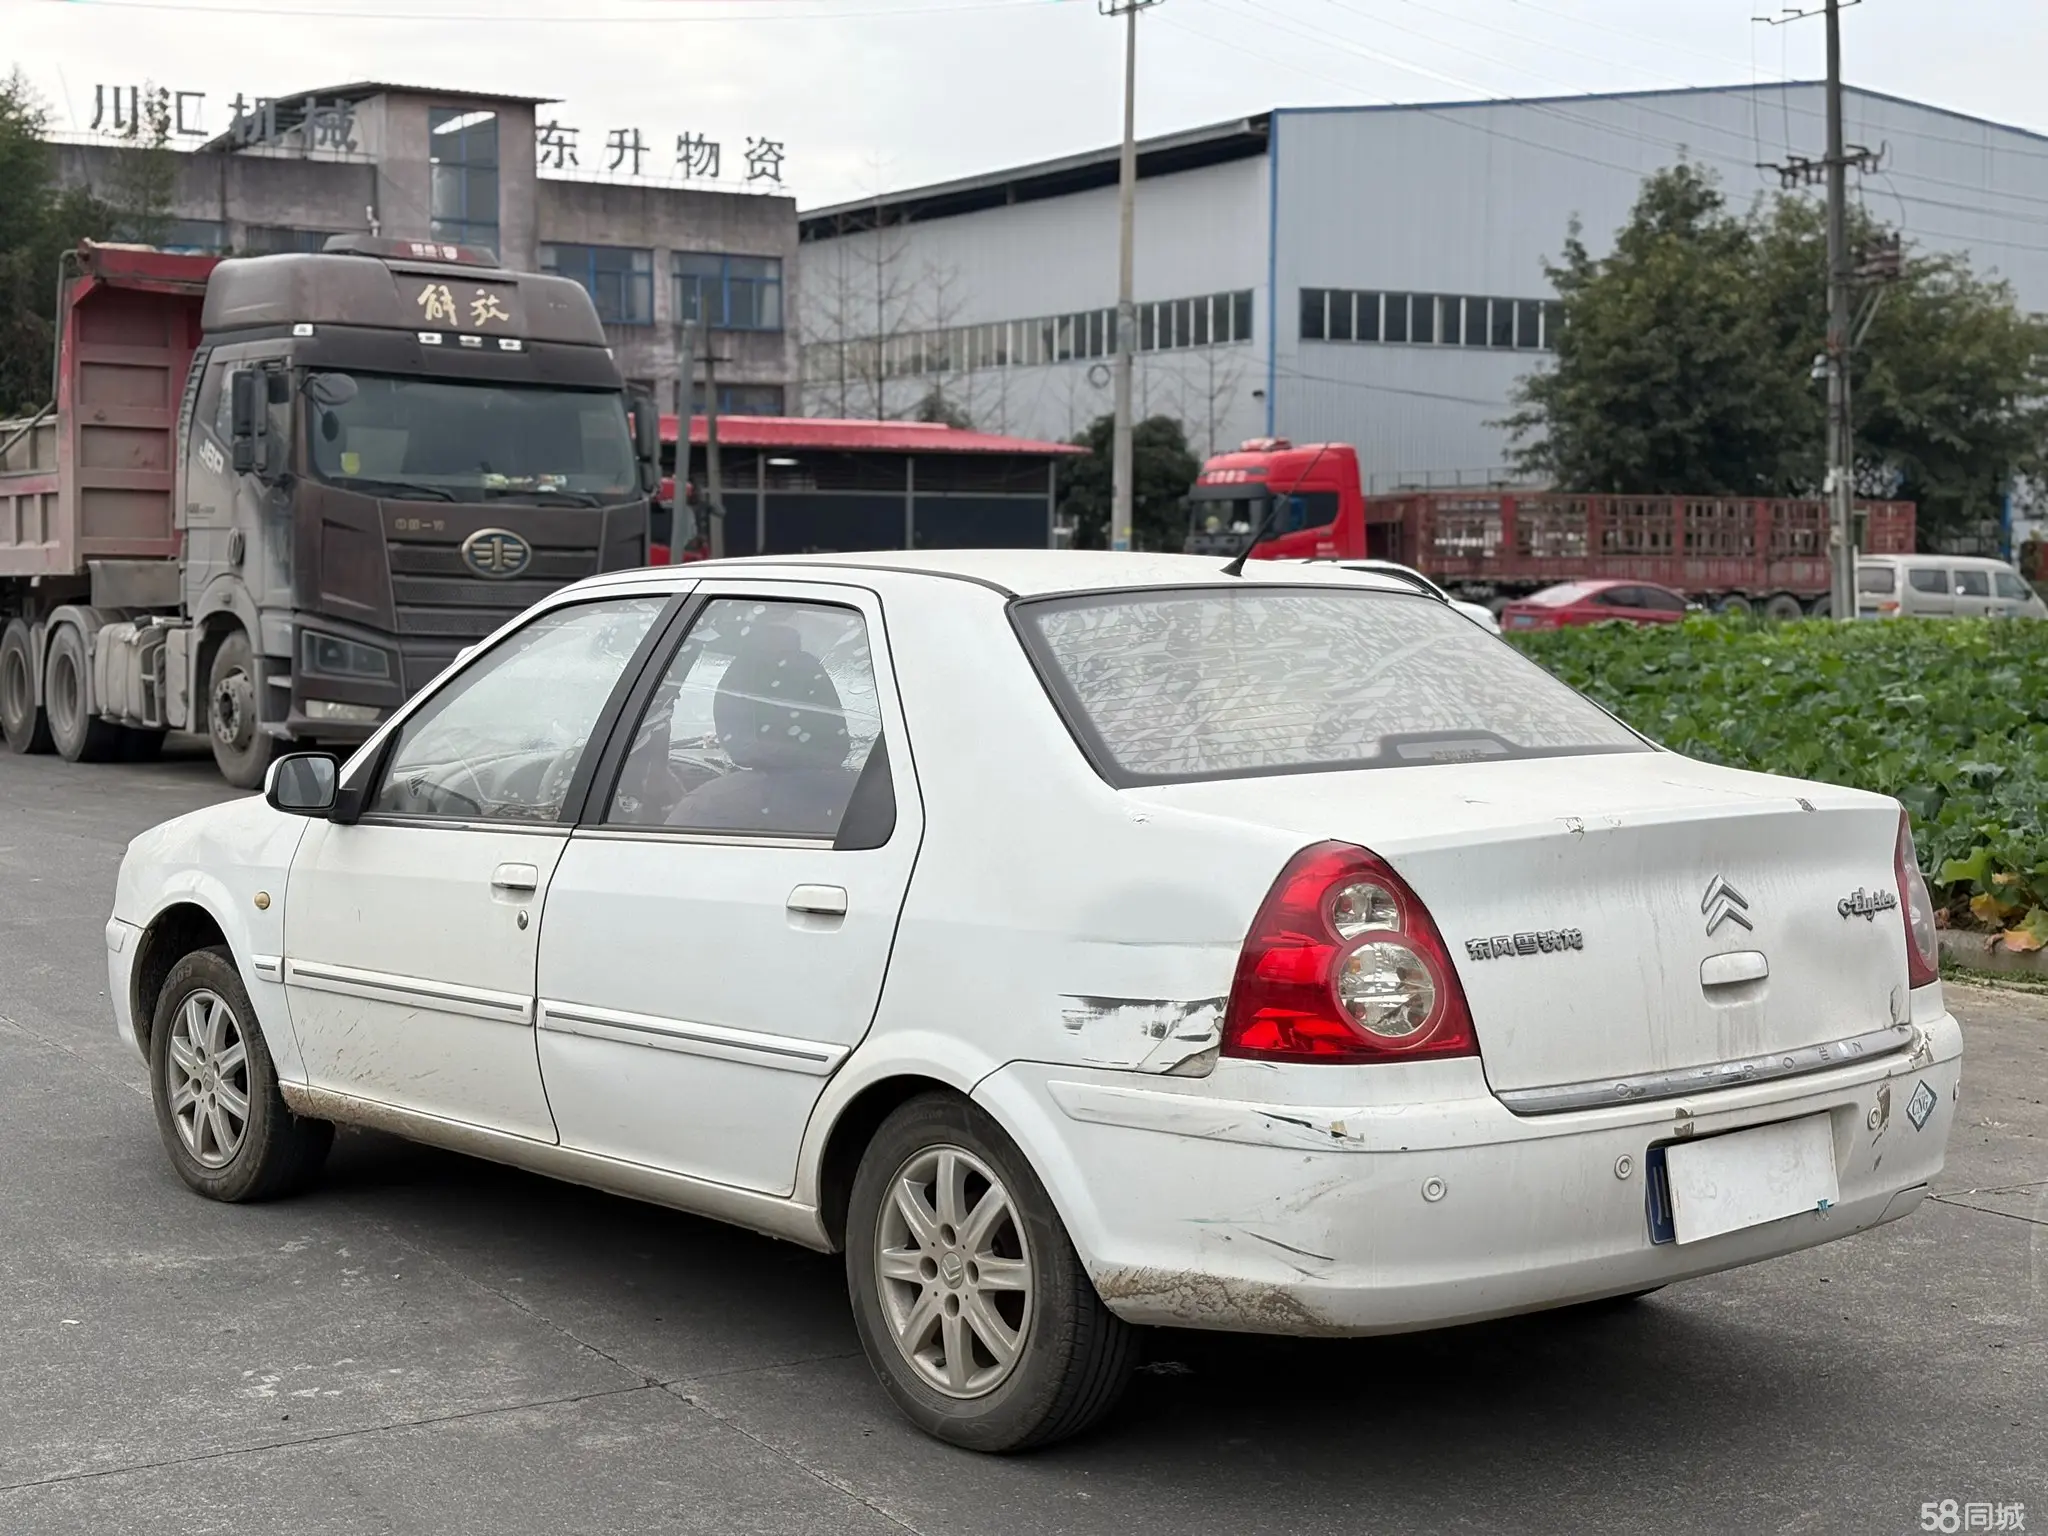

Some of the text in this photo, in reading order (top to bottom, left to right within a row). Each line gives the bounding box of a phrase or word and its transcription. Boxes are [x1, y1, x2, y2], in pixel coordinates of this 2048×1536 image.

[90, 84, 358, 153] 川汇机械
[535, 120, 785, 182] 东升物资
[417, 284, 510, 327] 解放
[1465, 928, 1583, 960] 东风雪铁龙
[1911, 1095, 1929, 1116] CNG
